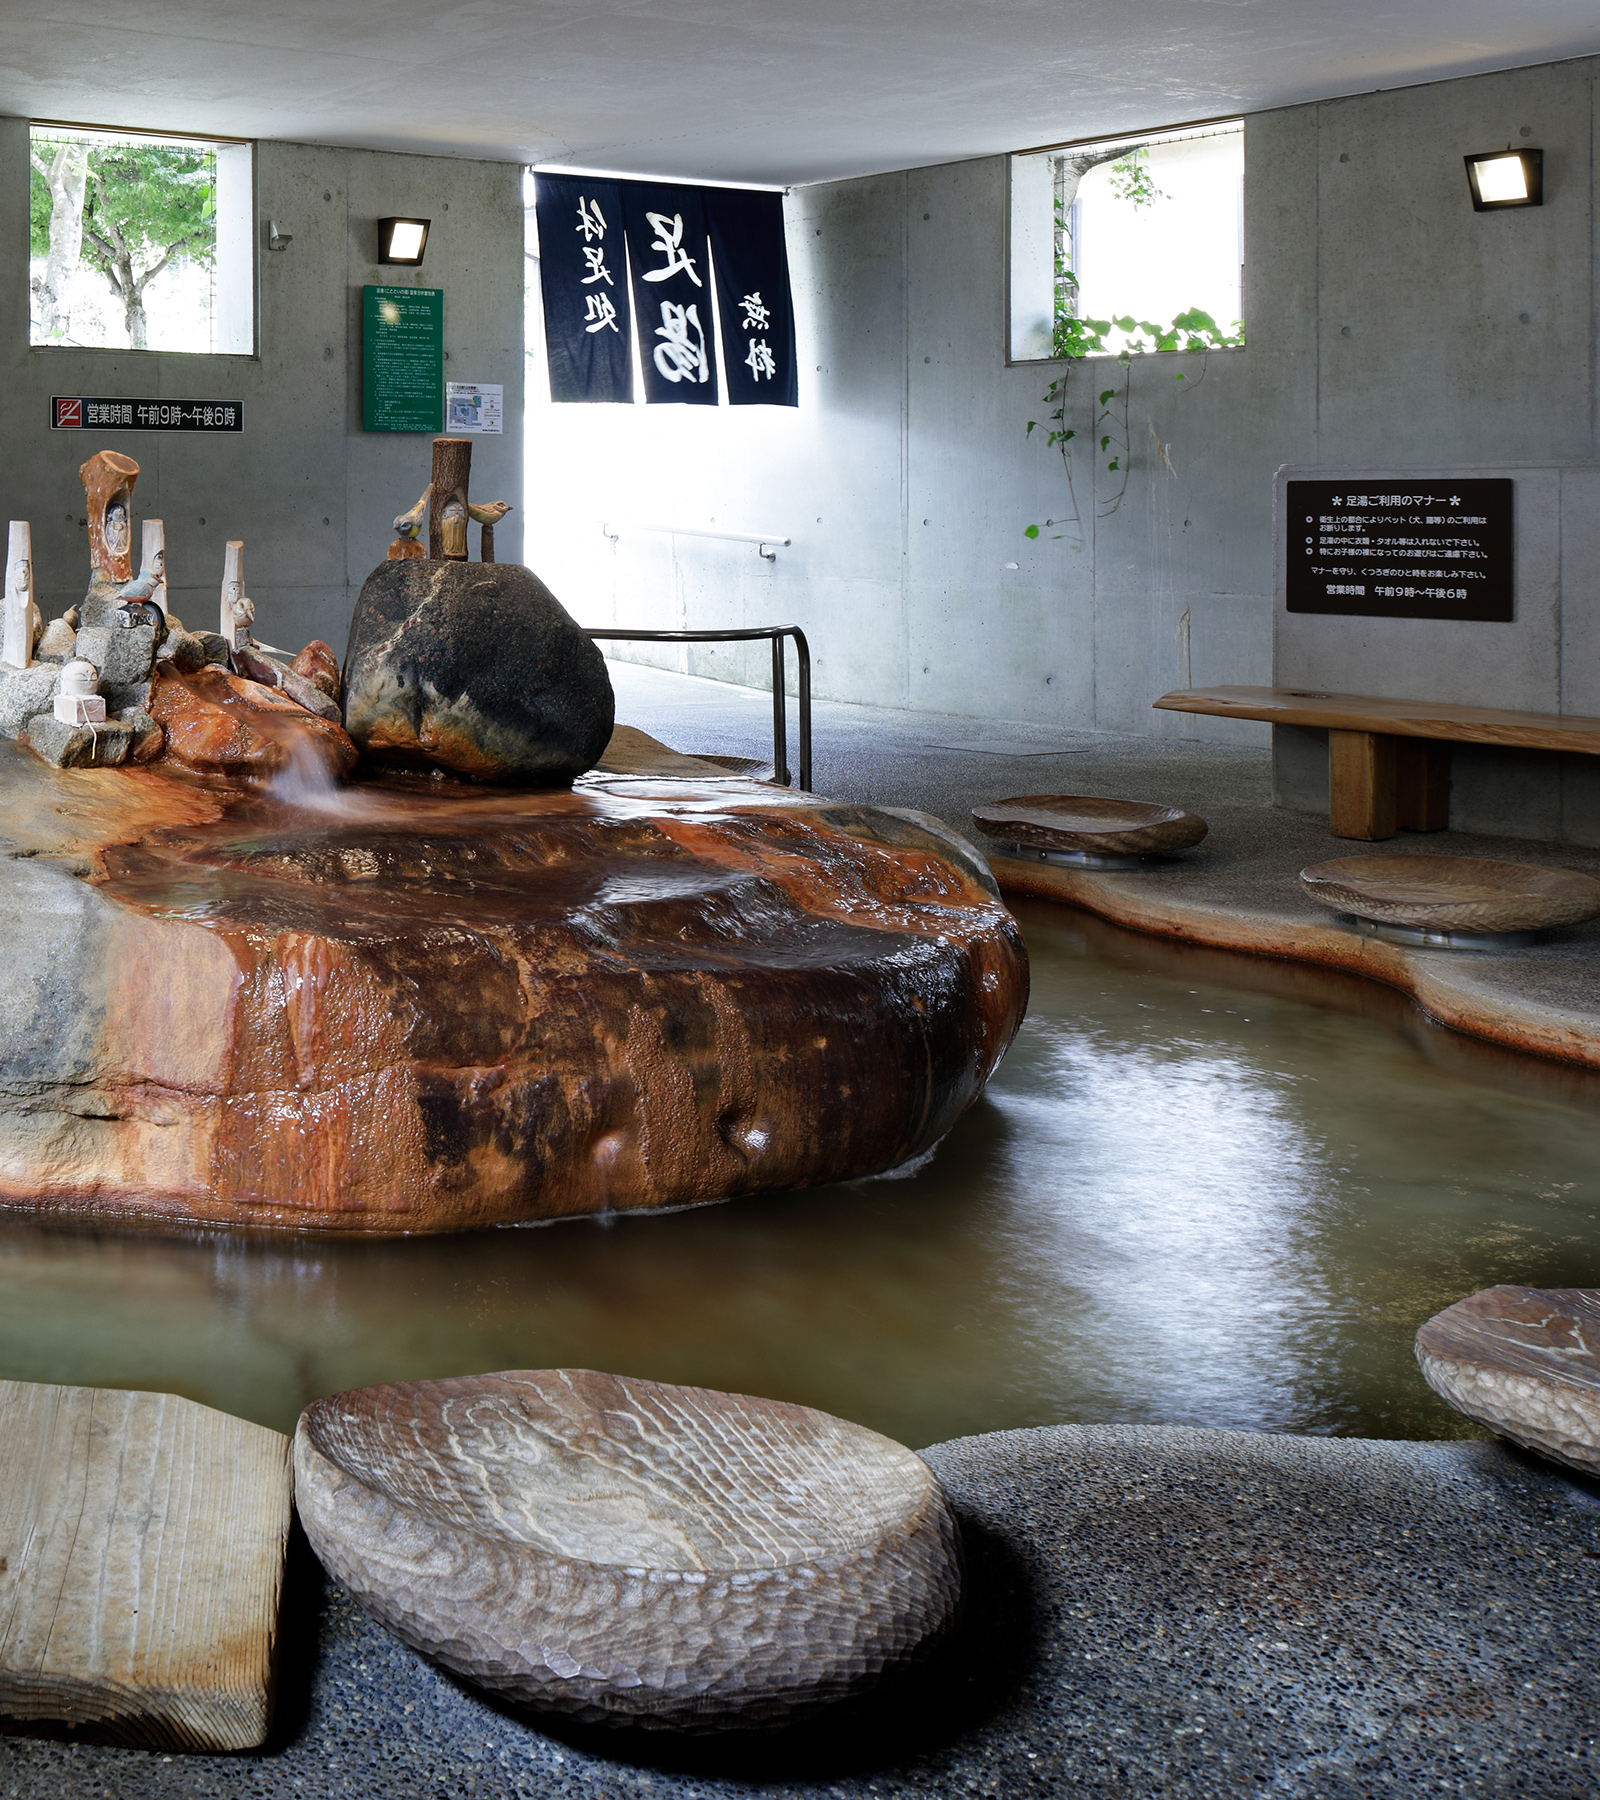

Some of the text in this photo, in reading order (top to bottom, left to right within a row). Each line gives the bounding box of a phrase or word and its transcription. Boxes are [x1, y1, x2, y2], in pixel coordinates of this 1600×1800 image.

[88, 404, 132, 424] 営業時間
[1346, 495, 1446, 506] 足湯ご利用のマナー
[1320, 524, 1365, 532] お断りします。
[1326, 585, 1365, 595] 営業時間
